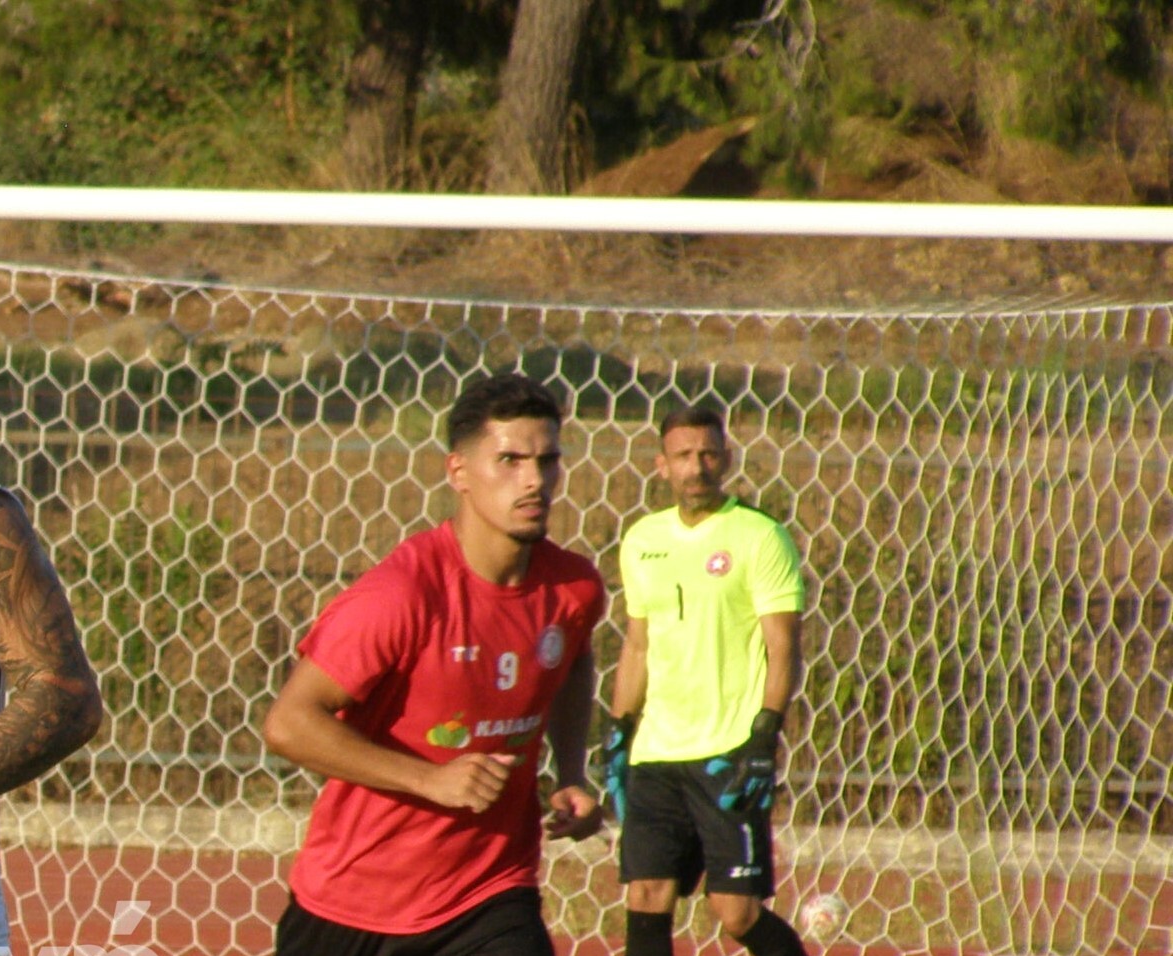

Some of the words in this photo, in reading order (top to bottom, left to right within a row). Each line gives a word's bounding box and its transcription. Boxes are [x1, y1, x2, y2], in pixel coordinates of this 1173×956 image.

[676, 583, 684, 621] 1
[497, 651, 520, 691] 9
[741, 823, 753, 865] 1
